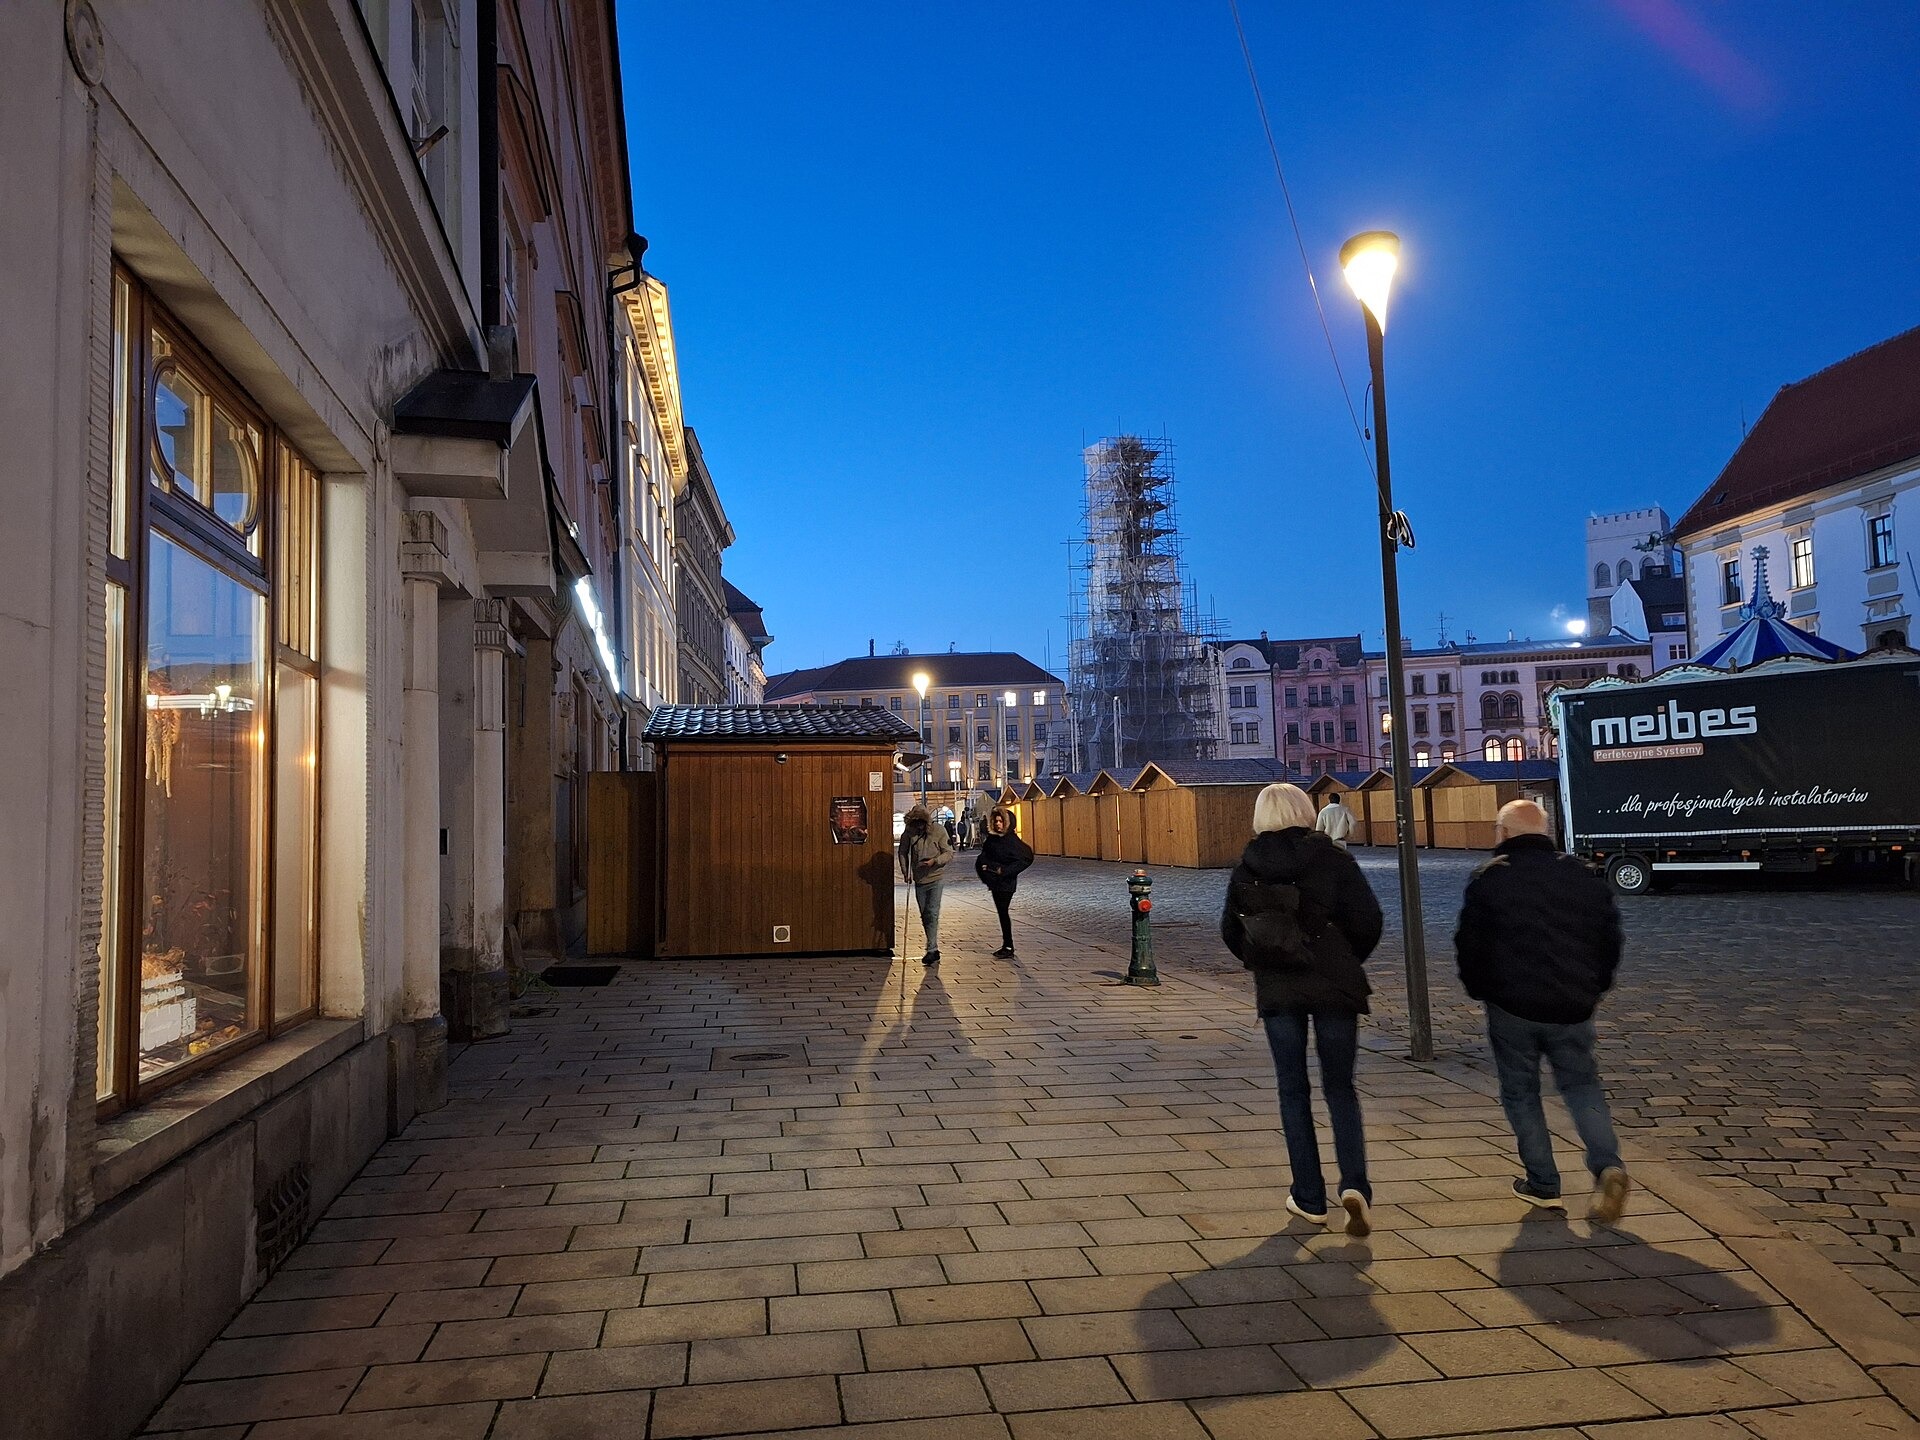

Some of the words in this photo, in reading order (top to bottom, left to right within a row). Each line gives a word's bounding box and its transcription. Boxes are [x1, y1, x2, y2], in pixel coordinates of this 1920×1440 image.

[1591, 700, 1758, 746] meibes
[1596, 748, 1654, 761] Perfekcyjne
[1656, 745, 1702, 758] Systemy
[1643, 788, 1765, 818] profesjonalnych
[1769, 785, 1868, 806] instalatorów
